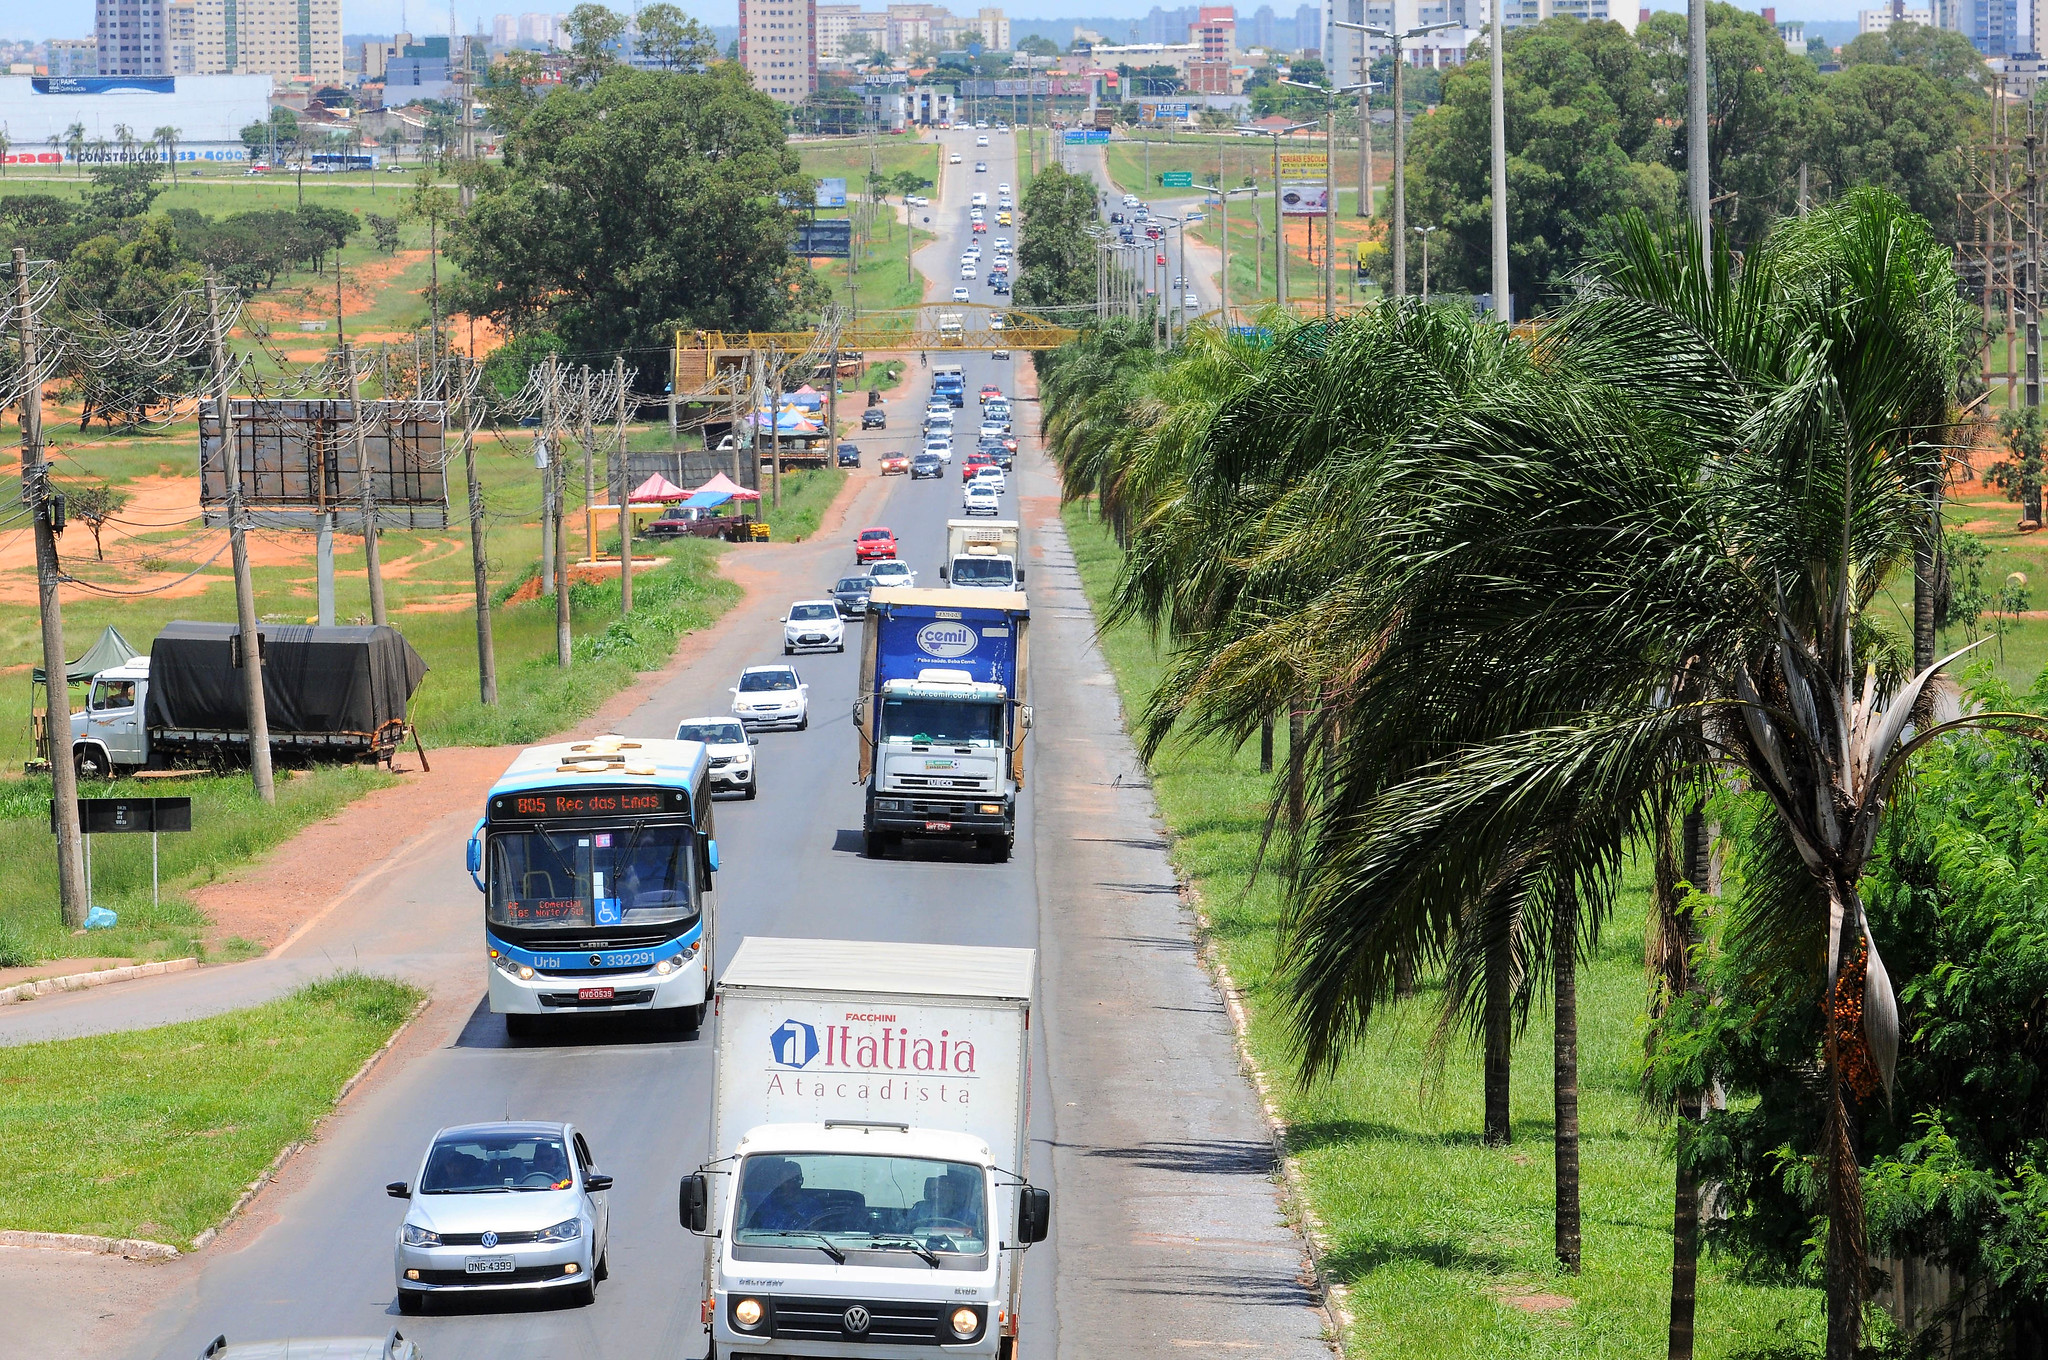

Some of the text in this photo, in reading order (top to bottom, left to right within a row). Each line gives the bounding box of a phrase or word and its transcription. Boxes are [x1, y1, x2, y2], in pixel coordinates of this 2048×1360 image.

[925, 629, 967, 643] cemil
[907, 690, 981, 700] www.cemil.com.br
[518, 797, 546, 813] 805
[556, 796, 583, 812] Rec
[589, 796, 617, 811] das
[539, 900, 582, 909] Comercial
[536, 908, 560, 917] Norte
[533, 951, 657, 968] Urbi 332291
[845, 1012, 896, 1022] FACCHINI
[825, 1025, 976, 1073] Itatiaia
[766, 1073, 970, 1104] Atacadista
